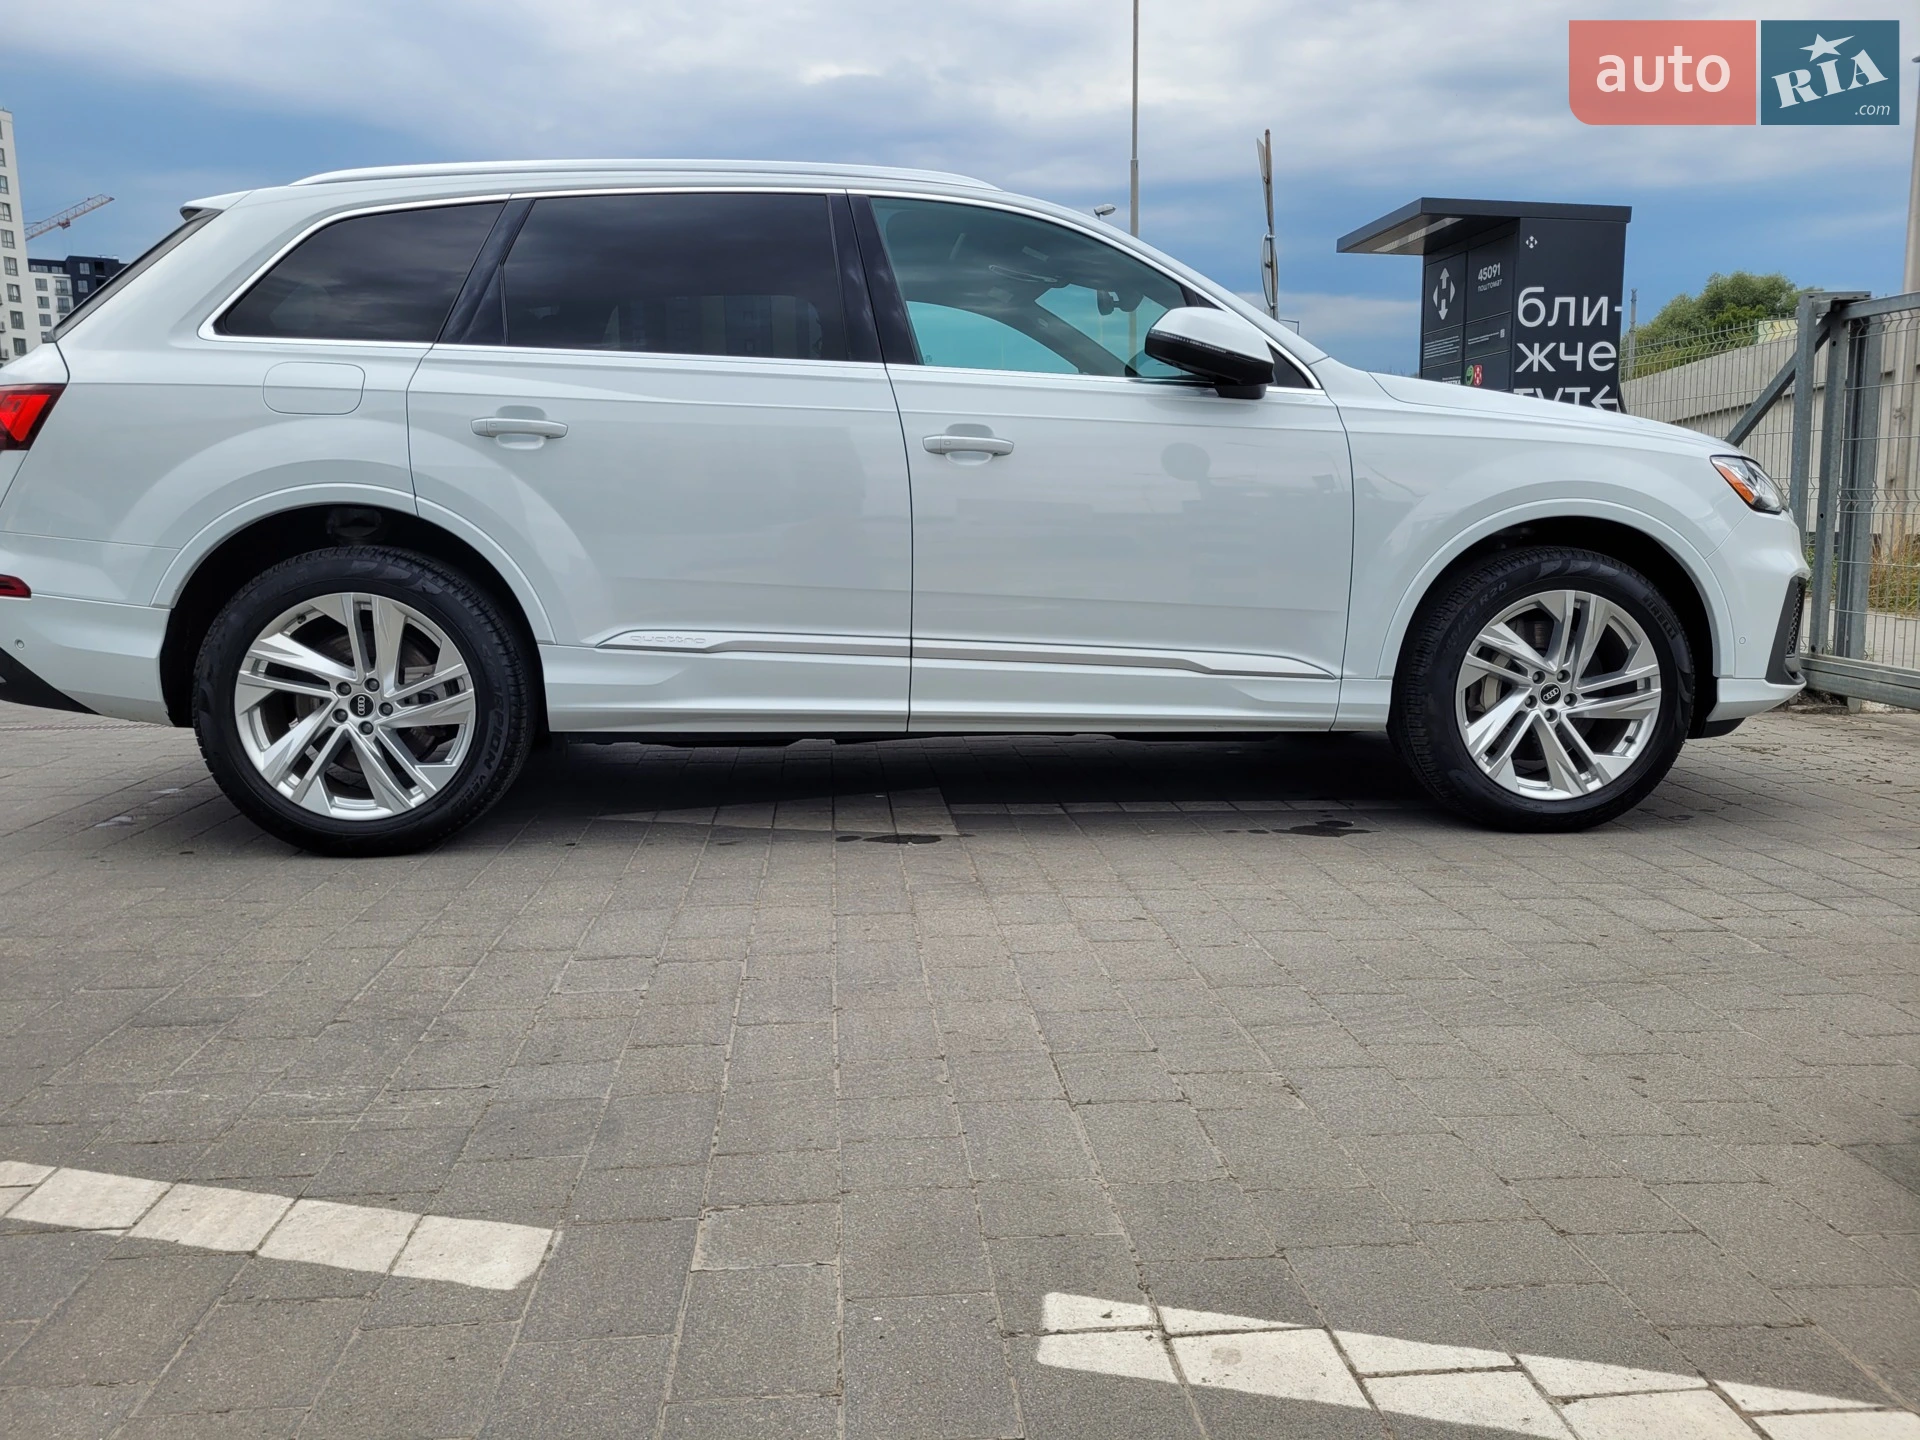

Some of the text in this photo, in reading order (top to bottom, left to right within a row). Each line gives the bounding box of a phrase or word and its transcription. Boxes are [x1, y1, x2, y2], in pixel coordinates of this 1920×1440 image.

[1478, 262, 1501, 281] 45091
[1478, 279, 1503, 292] поштомат
[1515, 341, 1617, 373] жче
[1478, 580, 1508, 607] R20
[630, 635, 706, 644] quattro
